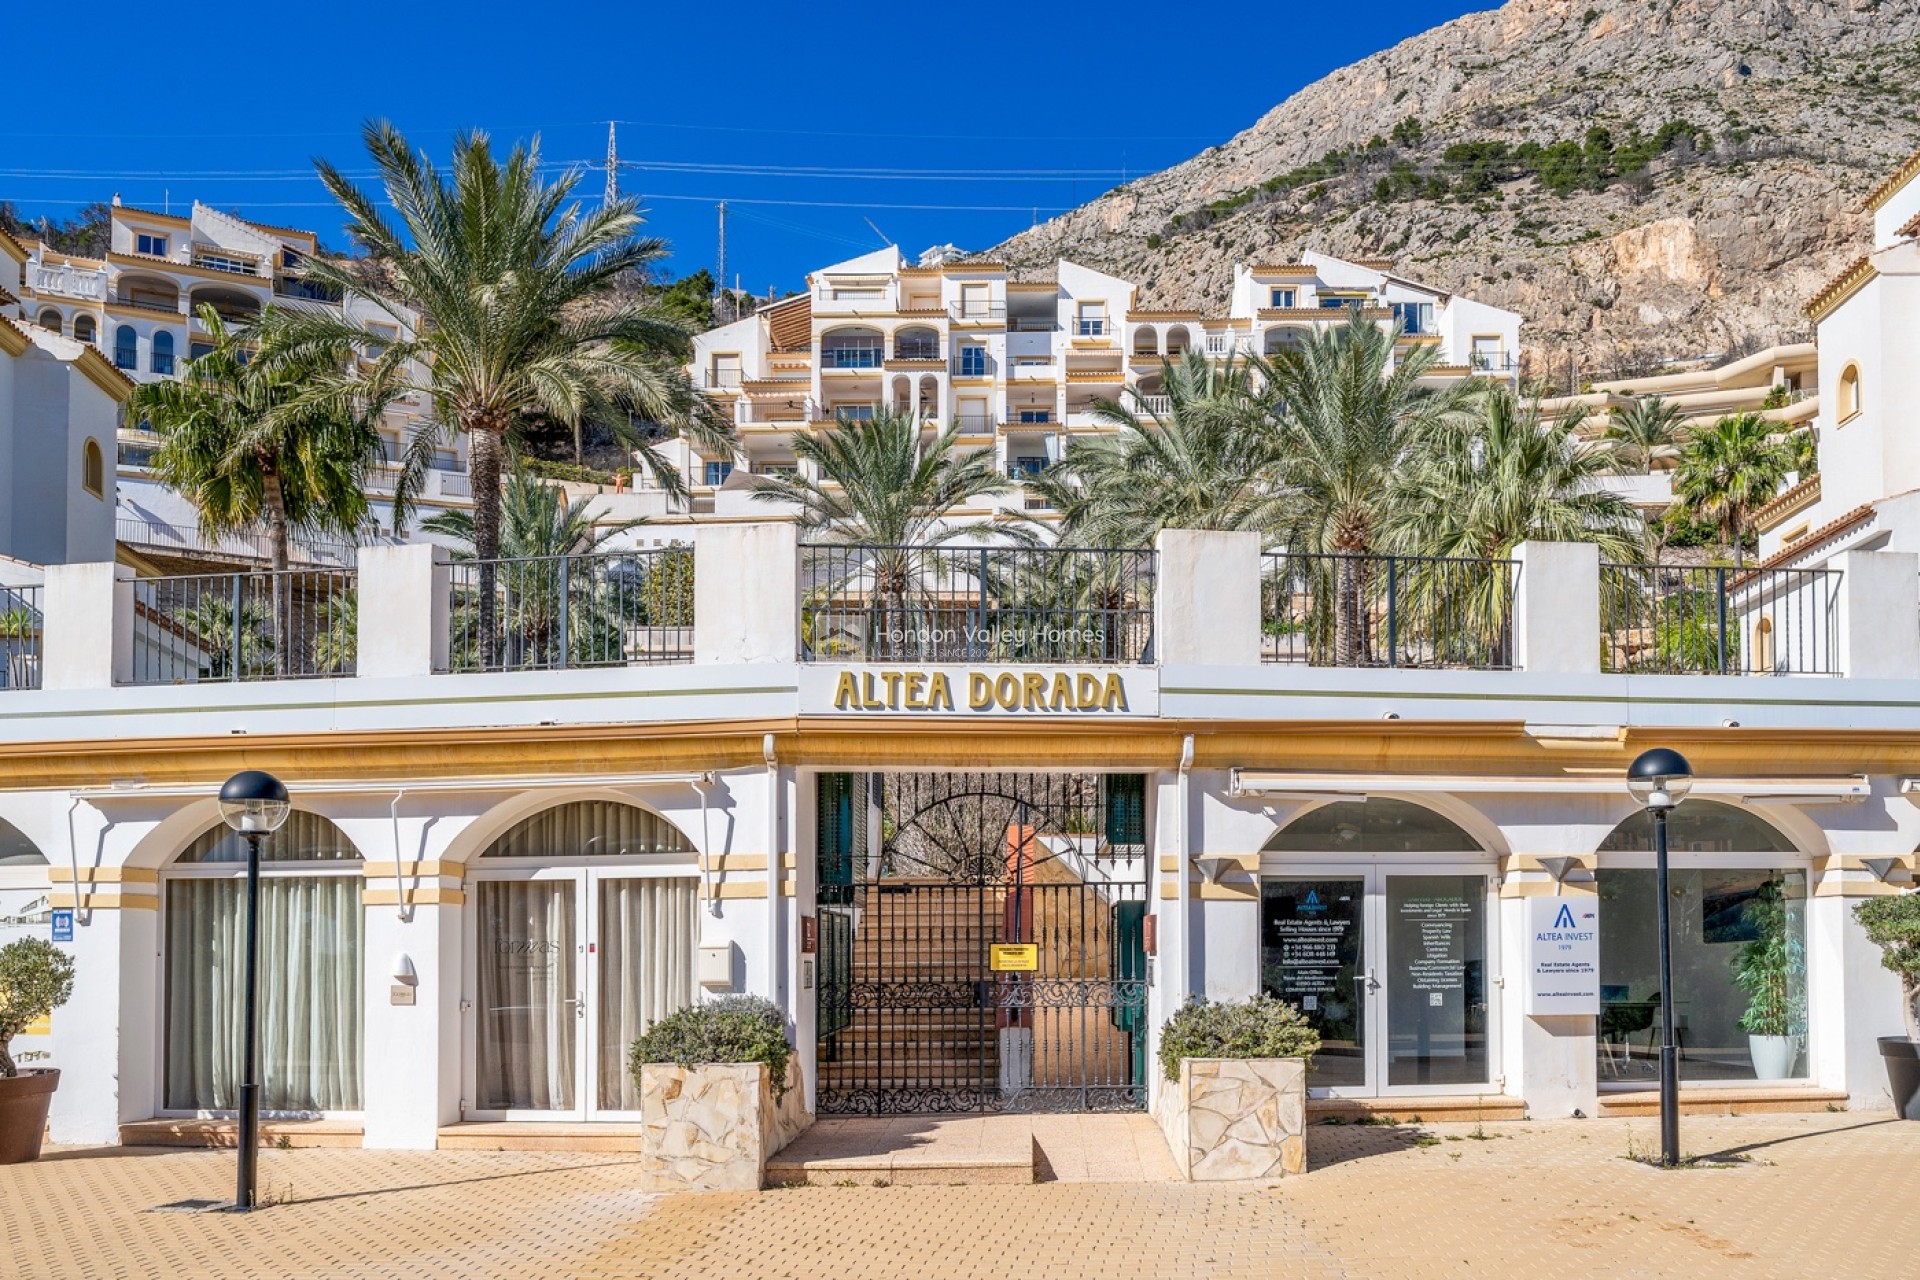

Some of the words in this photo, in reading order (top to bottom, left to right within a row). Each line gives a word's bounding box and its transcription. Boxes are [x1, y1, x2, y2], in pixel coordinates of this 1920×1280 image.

[834, 671, 950, 708] ALTEA
[968, 671, 1125, 708] DORADA
[1537, 932, 1563, 941] ALTEA
[1565, 932, 1594, 941] INVEST
